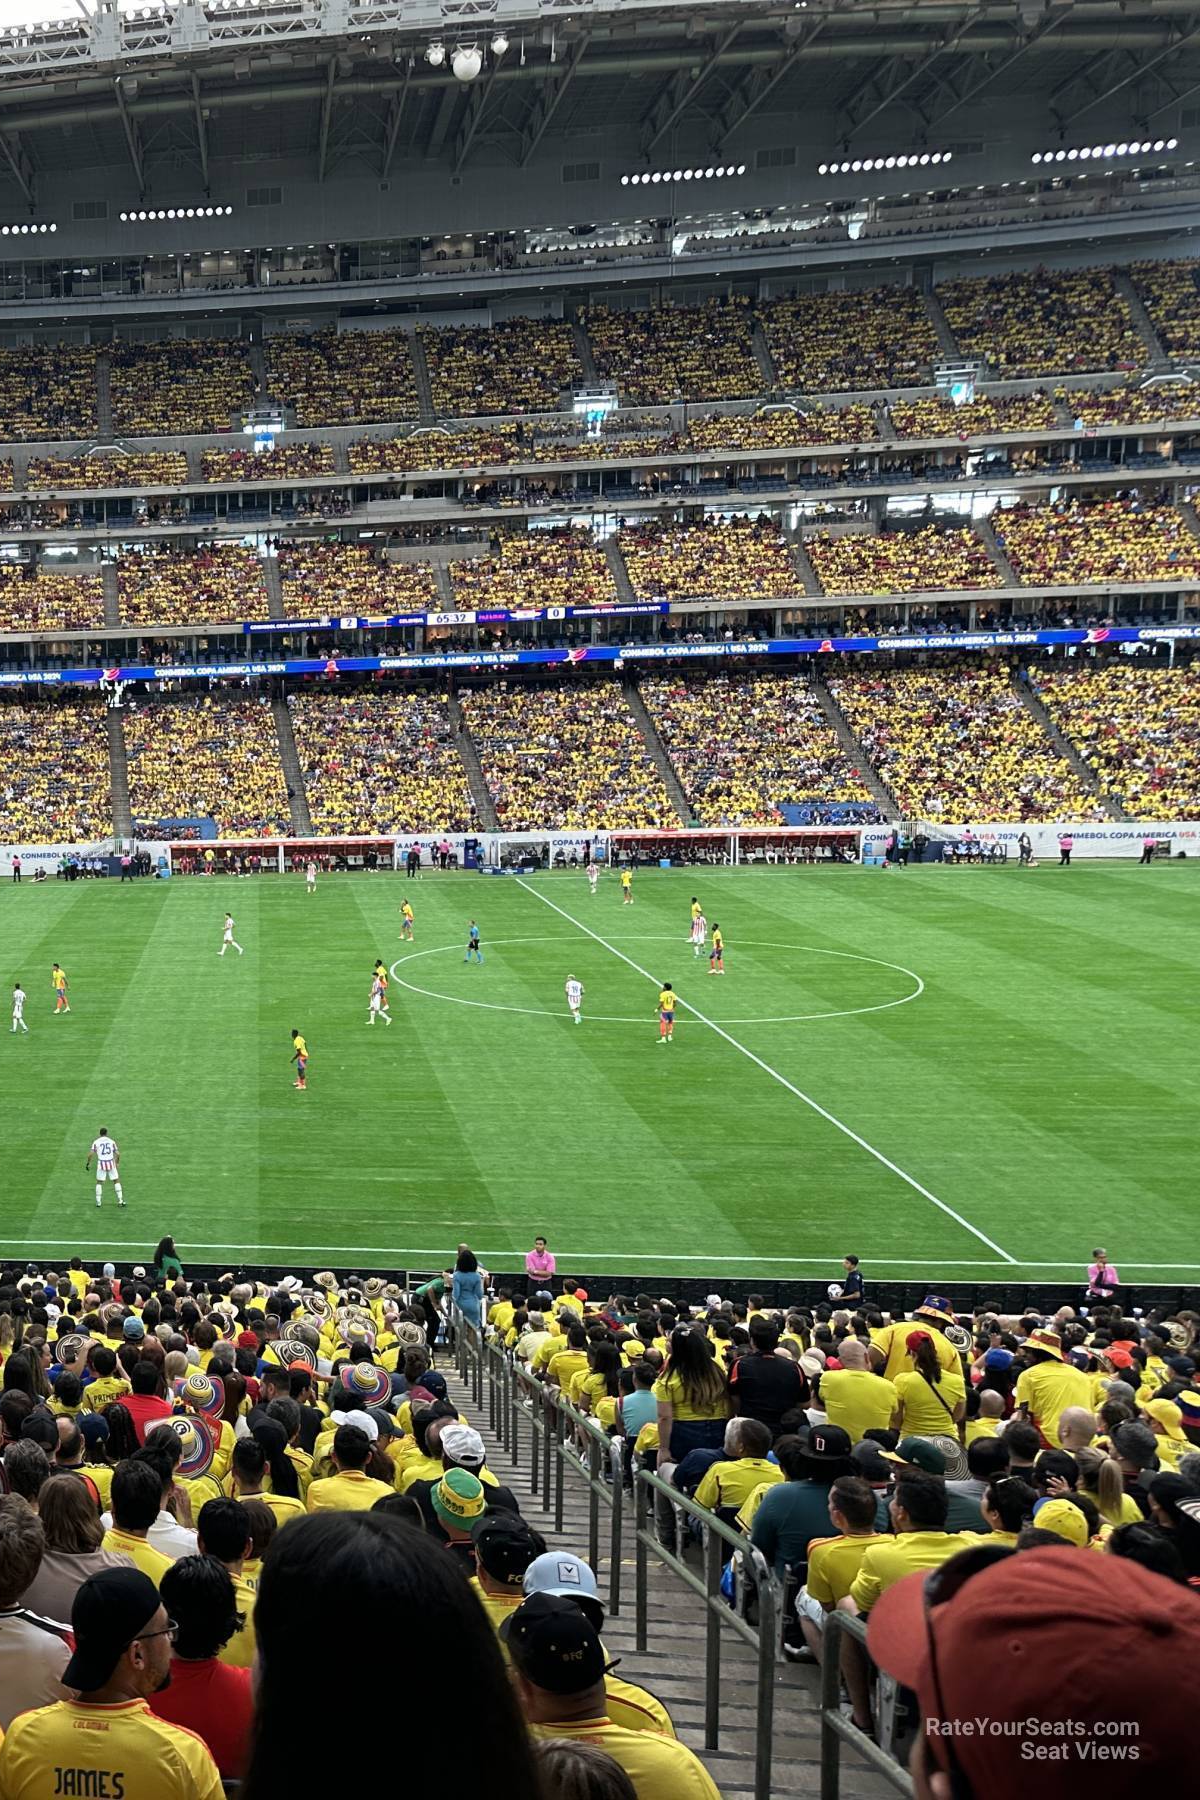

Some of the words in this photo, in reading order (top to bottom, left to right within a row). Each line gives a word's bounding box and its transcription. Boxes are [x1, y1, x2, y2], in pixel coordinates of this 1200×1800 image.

[436, 614, 466, 623] 65:32
[552, 609, 559, 617] 0
[346, 619, 353, 627] 2
[878, 639, 928, 648] CONMEBOL
[928, 638, 952, 646] COPA
[953, 636, 994, 644] AMERICA
[996, 635, 1013, 643] USA
[1014, 634, 1037, 642] 2024
[620, 648, 666, 657] CONMEBOL
[667, 647, 689, 655] COPA
[730, 644, 747, 653] USA
[748, 643, 768, 652] 2024
[380, 659, 424, 667] CONMEBOL
[424, 657, 446, 665] COPA
[446, 656, 482, 664] AMERICA
[483, 655, 499, 663] USA
[499, 654, 519, 662] 2024
[553, 838, 575, 846] COPA
[100, 1142, 111, 1155] 25
[54, 1767, 125, 1800] JAMES
